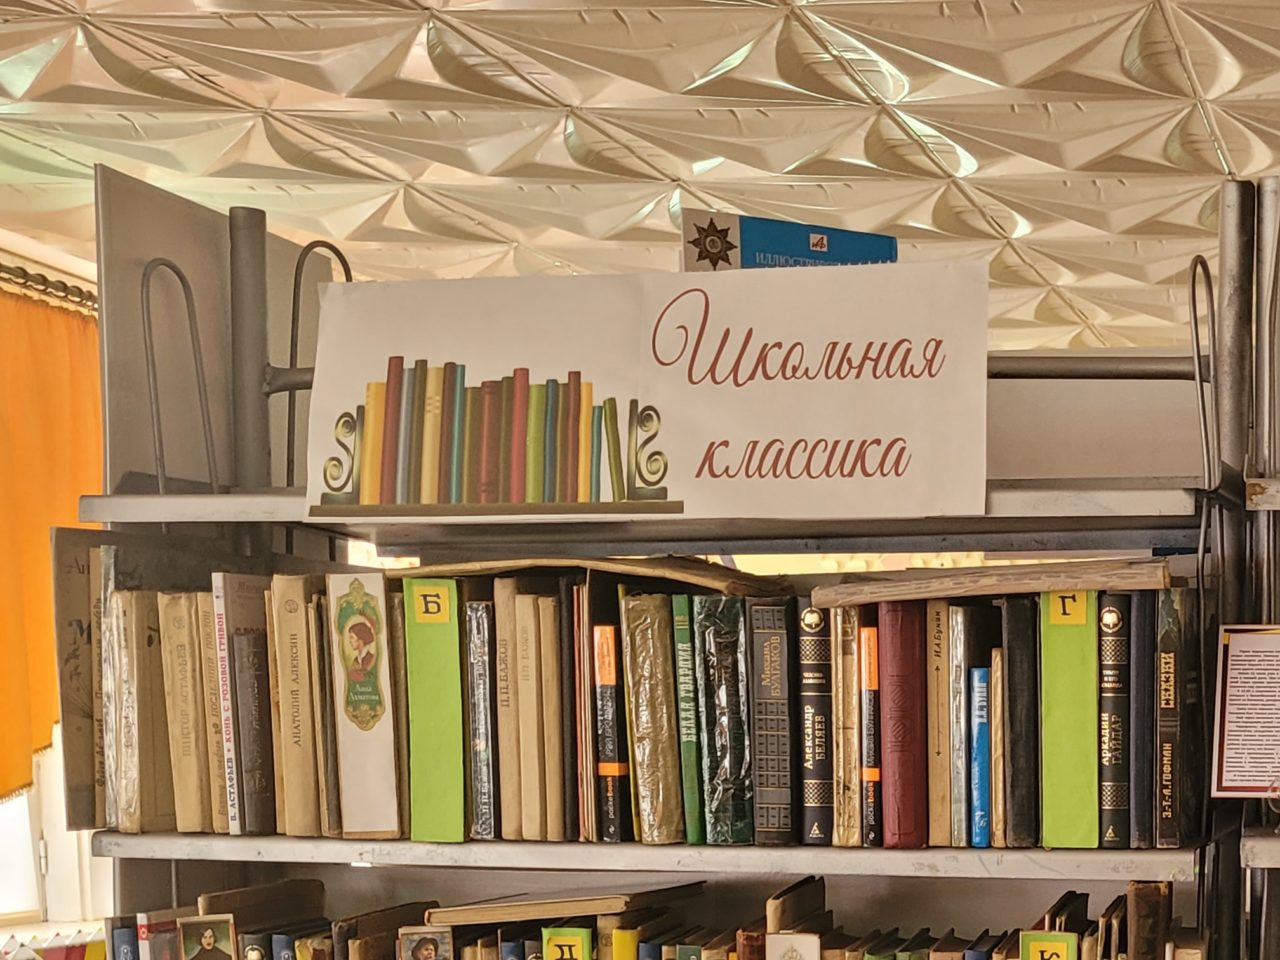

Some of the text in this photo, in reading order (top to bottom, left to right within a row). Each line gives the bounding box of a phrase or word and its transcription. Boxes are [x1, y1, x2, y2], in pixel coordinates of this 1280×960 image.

[652, 287, 945, 387] Школьная
[695, 427, 912, 480] классика
[420, 593, 441, 615] Б
[1060, 594, 1077, 616] Г
[288, 632, 302, 747] АНАТОЛИЙ АЛЕКСИН
[676, 642, 697, 743] БЕЛАЯ ГВАРДИЯ
[762, 641, 771, 687] Михаил
[770, 635, 782, 697] БУЛГАКОВ
[1160, 651, 1175, 708] СКАЗКИ
[223, 715, 237, 810] АСТАФЬЕВ КОНЬ
[803, 705, 814, 770] Александр
[814, 715, 826, 761] БЕЛЯЕВ
[1111, 715, 1123, 765] ГАЙДАР
